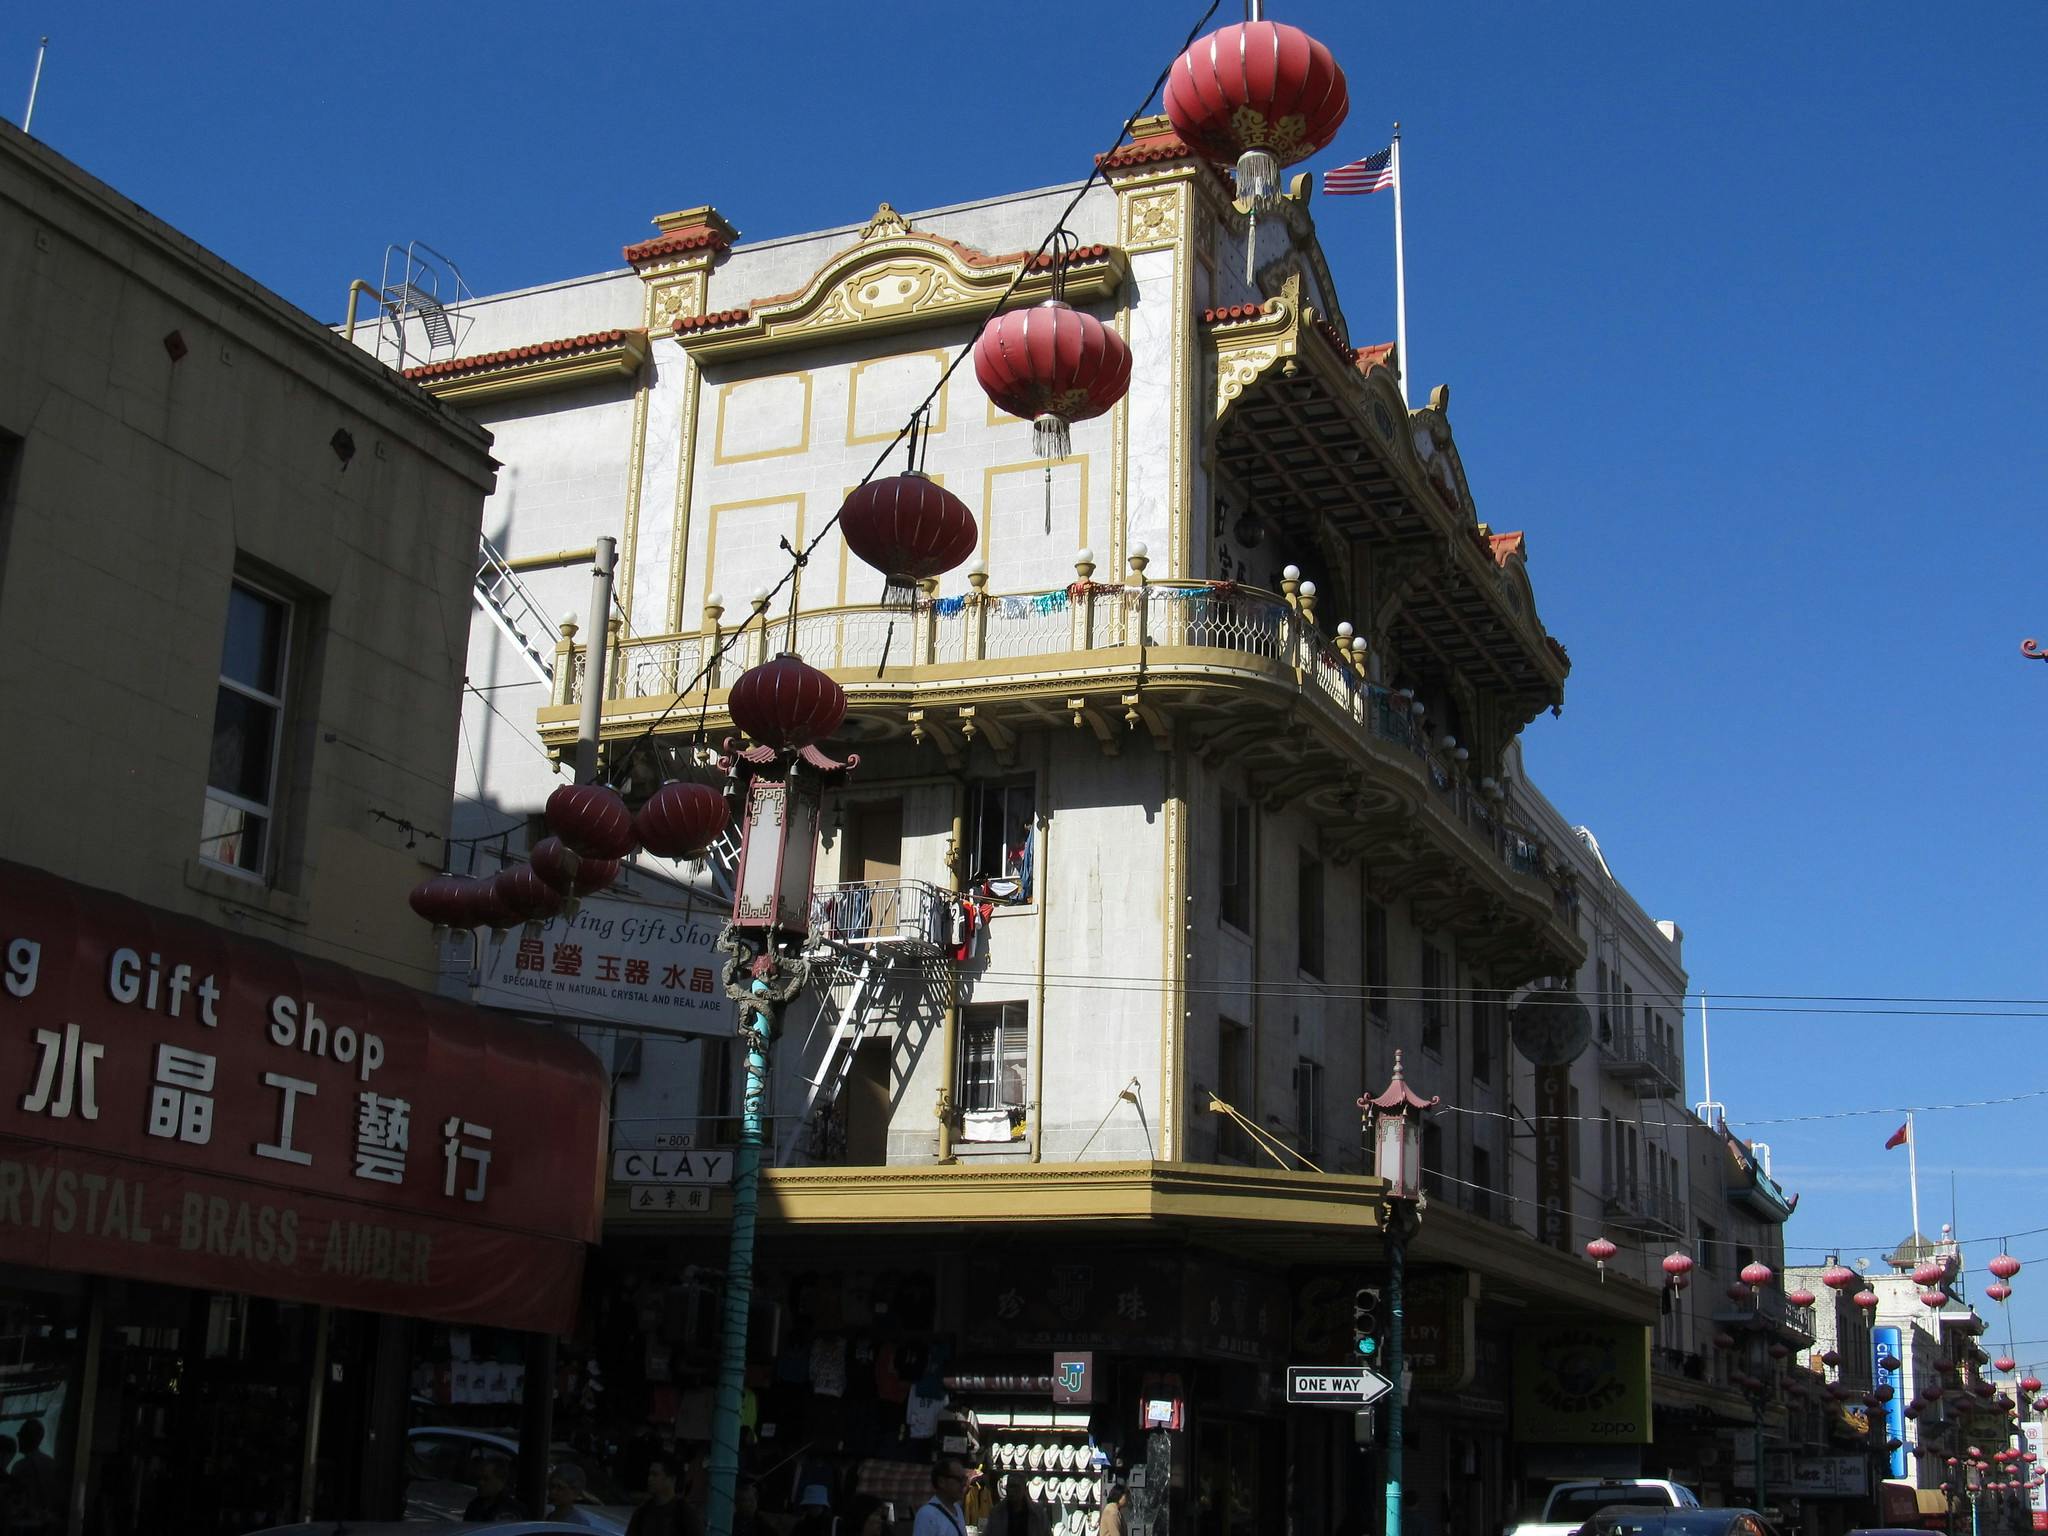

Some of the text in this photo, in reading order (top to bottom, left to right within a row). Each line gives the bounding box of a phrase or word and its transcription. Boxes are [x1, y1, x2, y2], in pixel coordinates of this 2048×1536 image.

[621, 917, 666, 944] Gift
[595, 954, 650, 986] 玉器
[661, 964, 714, 994] 水晶
[502, 974, 721, 1011] SPECIALIZE IN NATURAL CRYSTAL AND REAL JADE
[110, 947, 220, 1027] Gift
[270, 995, 385, 1080] Shop
[668, 1135, 690, 1146] 800
[625, 1155, 722, 1178] CLAY
[179, 1191, 299, 1266] BRASS
[321, 1220, 433, 1286] AMBER
[1298, 1378, 1361, 1392] ONE WAY
[1590, 1420, 1636, 1436] zippo
